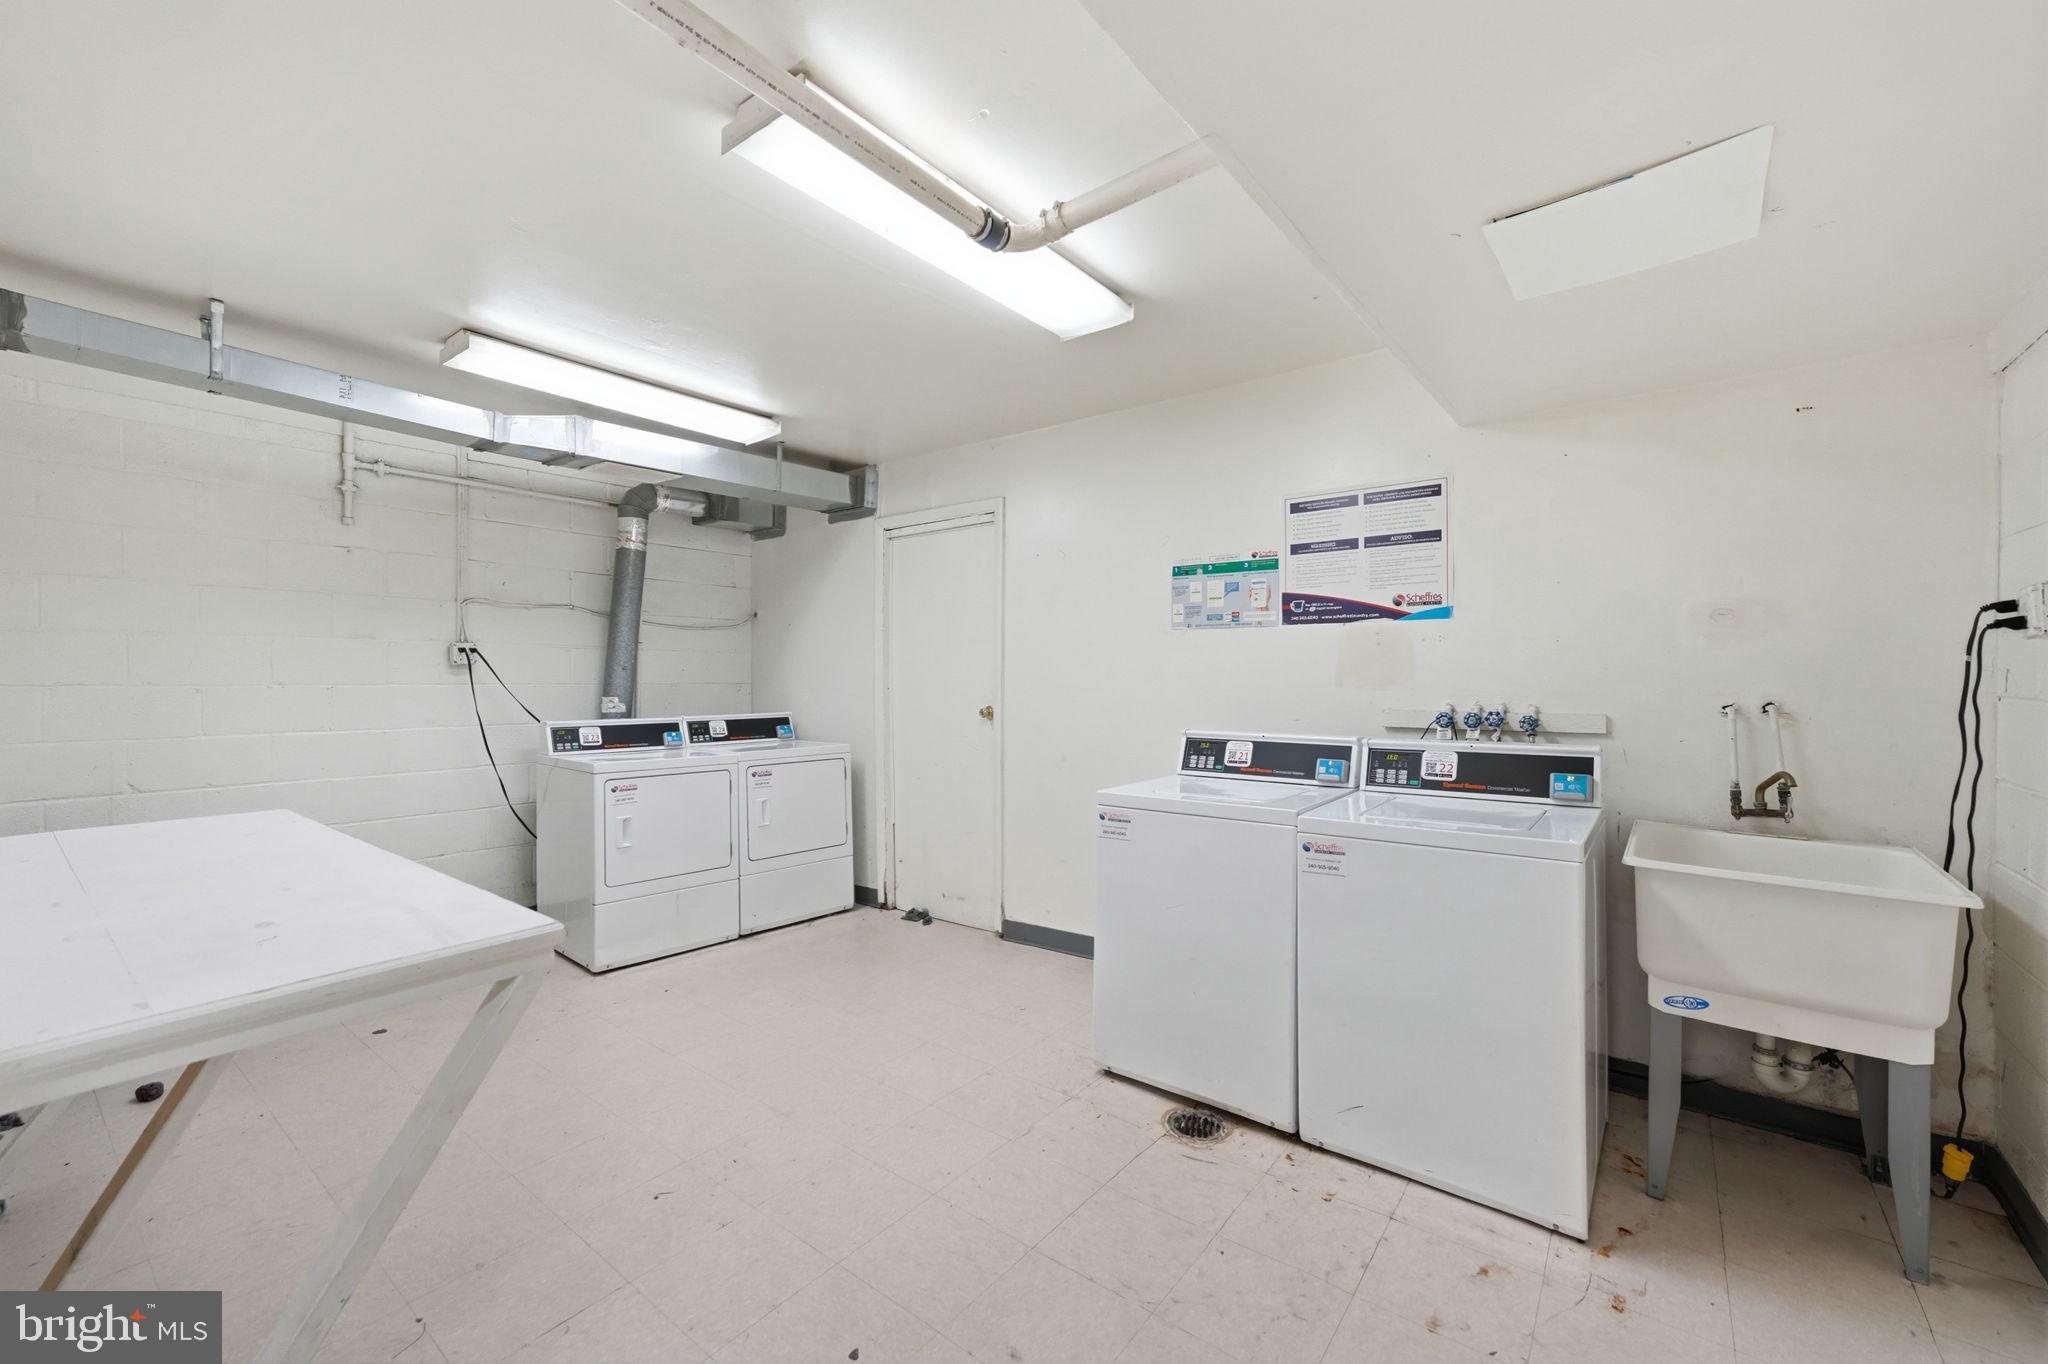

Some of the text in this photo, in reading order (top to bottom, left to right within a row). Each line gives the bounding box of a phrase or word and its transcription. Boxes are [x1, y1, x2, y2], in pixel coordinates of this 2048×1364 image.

[1406, 592, 1443, 602] Scheffres
[1238, 751, 1249, 760] 21
[1439, 763, 1454, 773] 22
